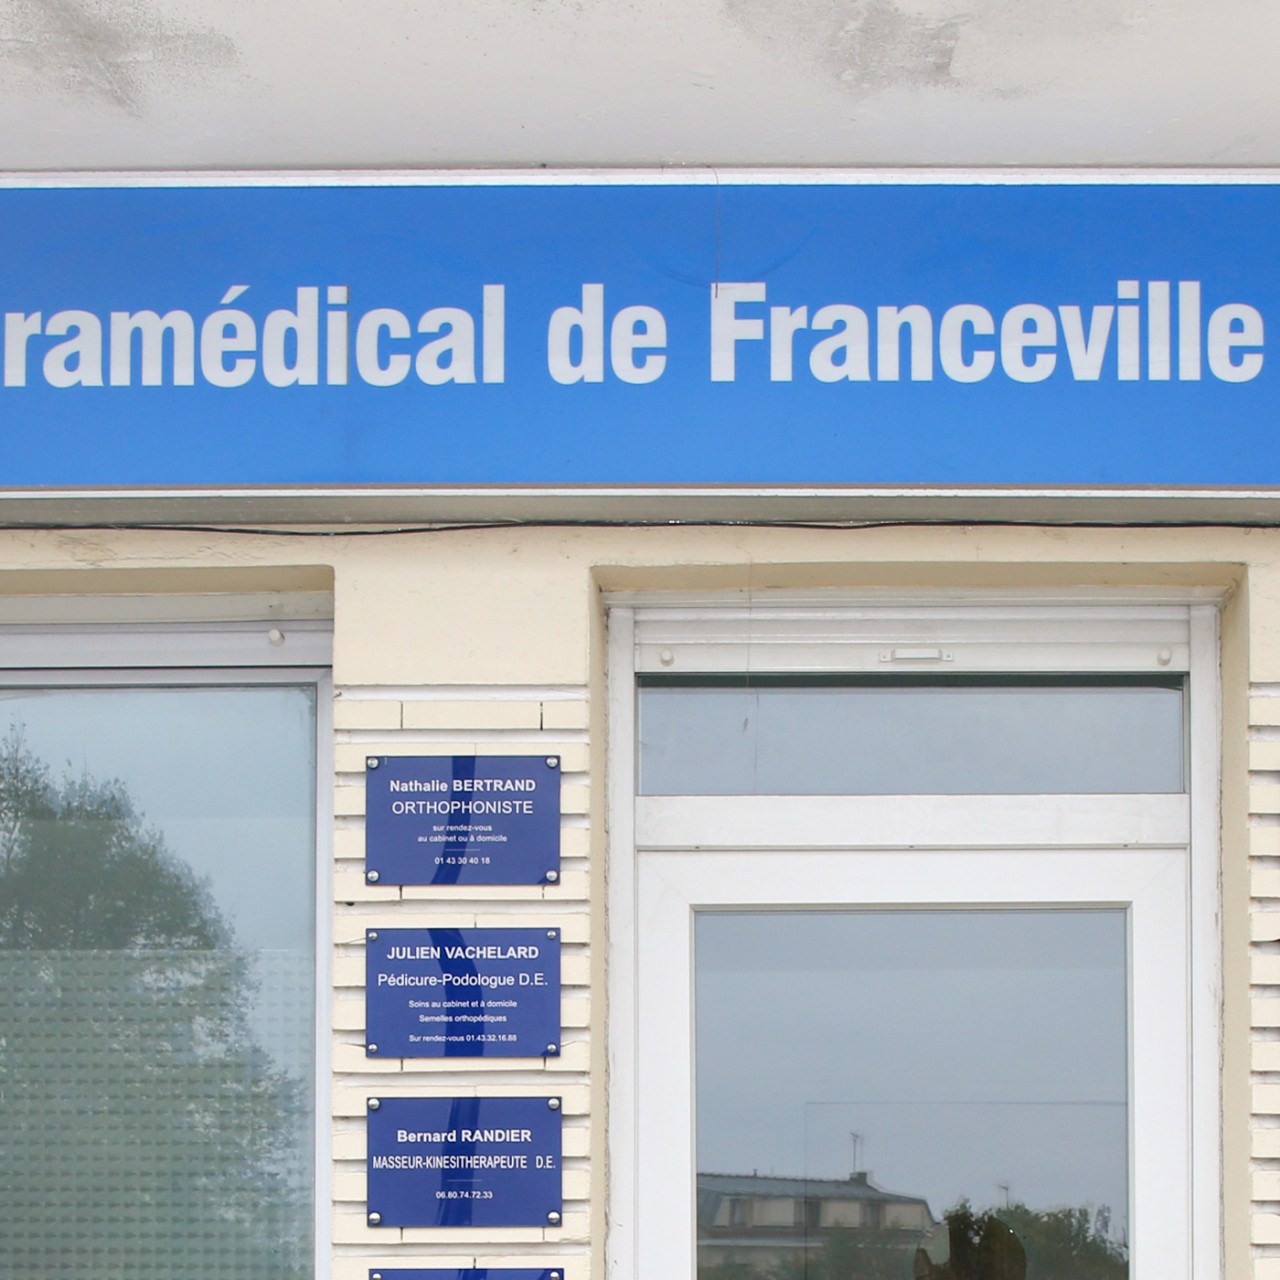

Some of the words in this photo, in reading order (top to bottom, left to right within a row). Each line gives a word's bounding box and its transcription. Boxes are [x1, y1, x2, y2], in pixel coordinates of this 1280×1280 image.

[547, 283, 667, 385] de
[710, 279, 1264, 383] Franceville
[389, 778, 449, 793] Nathalie
[452, 778, 537, 793] BERTRAND
[391, 799, 534, 815] ORTHOPHONISTE
[446, 824, 493, 832] rendez-vous
[428, 834, 457, 843] cabinet
[469, 834, 476, 843] à
[476, 834, 508, 843] domicile
[434, 856, 444, 865] 01
[445, 856, 457, 865] 43
[457, 856, 468, 865] 30
[468, 856, 479, 865] 40
[480, 856, 491, 865] 18
[386, 945, 441, 960] JULIEN
[443, 945, 540, 960] VACHELARD
[377, 972, 516, 988] Pédicure-Podologue
[518, 974, 549, 987] D.E.
[408, 999, 430, 1008] Soins
[442, 999, 470, 1008] cabinet
[470, 999, 479, 1008] et
[480, 999, 486, 1008] à
[486, 999, 518, 1008] domicile
[418, 1014, 454, 1023] Semelles
[454, 1014, 508, 1023] orthopédiques
[408, 1033, 422, 1042] Sur
[422, 1033, 465, 1042] rendez-vous
[396, 1129, 457, 1143] Bernard
[460, 1129, 533, 1143] RANDIER
[372, 1155, 528, 1170] MASSEUR-KINESITHERAPEUTE
[535, 1155, 557, 1170] D.E.
[435, 1190, 494, 1200] 06.80.74.72.33
